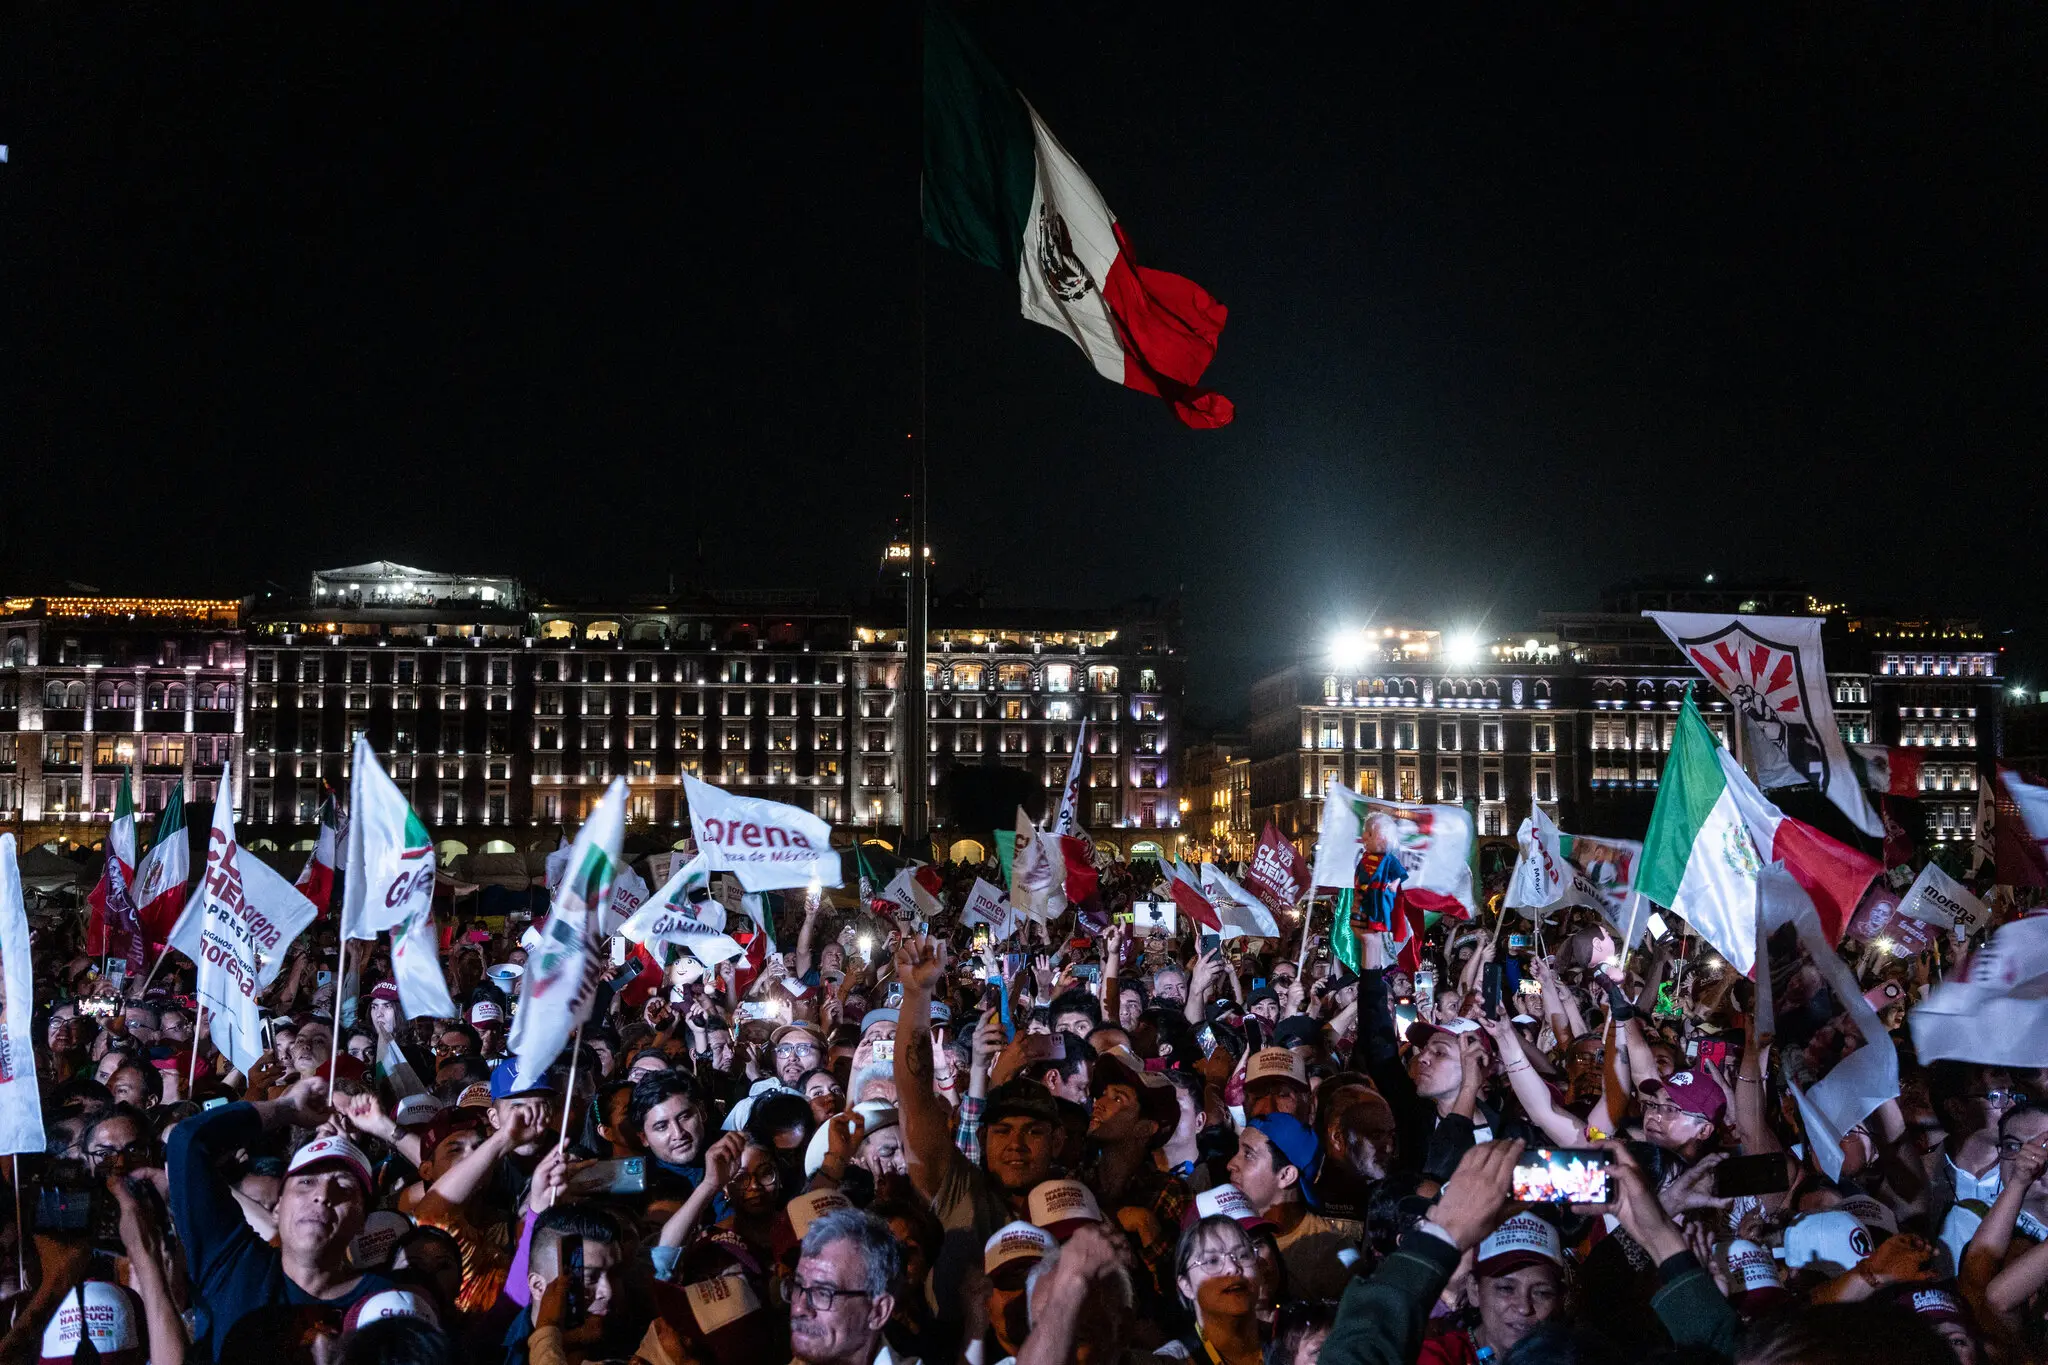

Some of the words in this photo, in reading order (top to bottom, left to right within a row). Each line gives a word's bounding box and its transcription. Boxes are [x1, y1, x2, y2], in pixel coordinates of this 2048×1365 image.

[702, 818, 812, 849] orena
[975, 893, 1006, 918] moren
[1924, 885, 1977, 924] morena
[245, 904, 282, 950] orena
